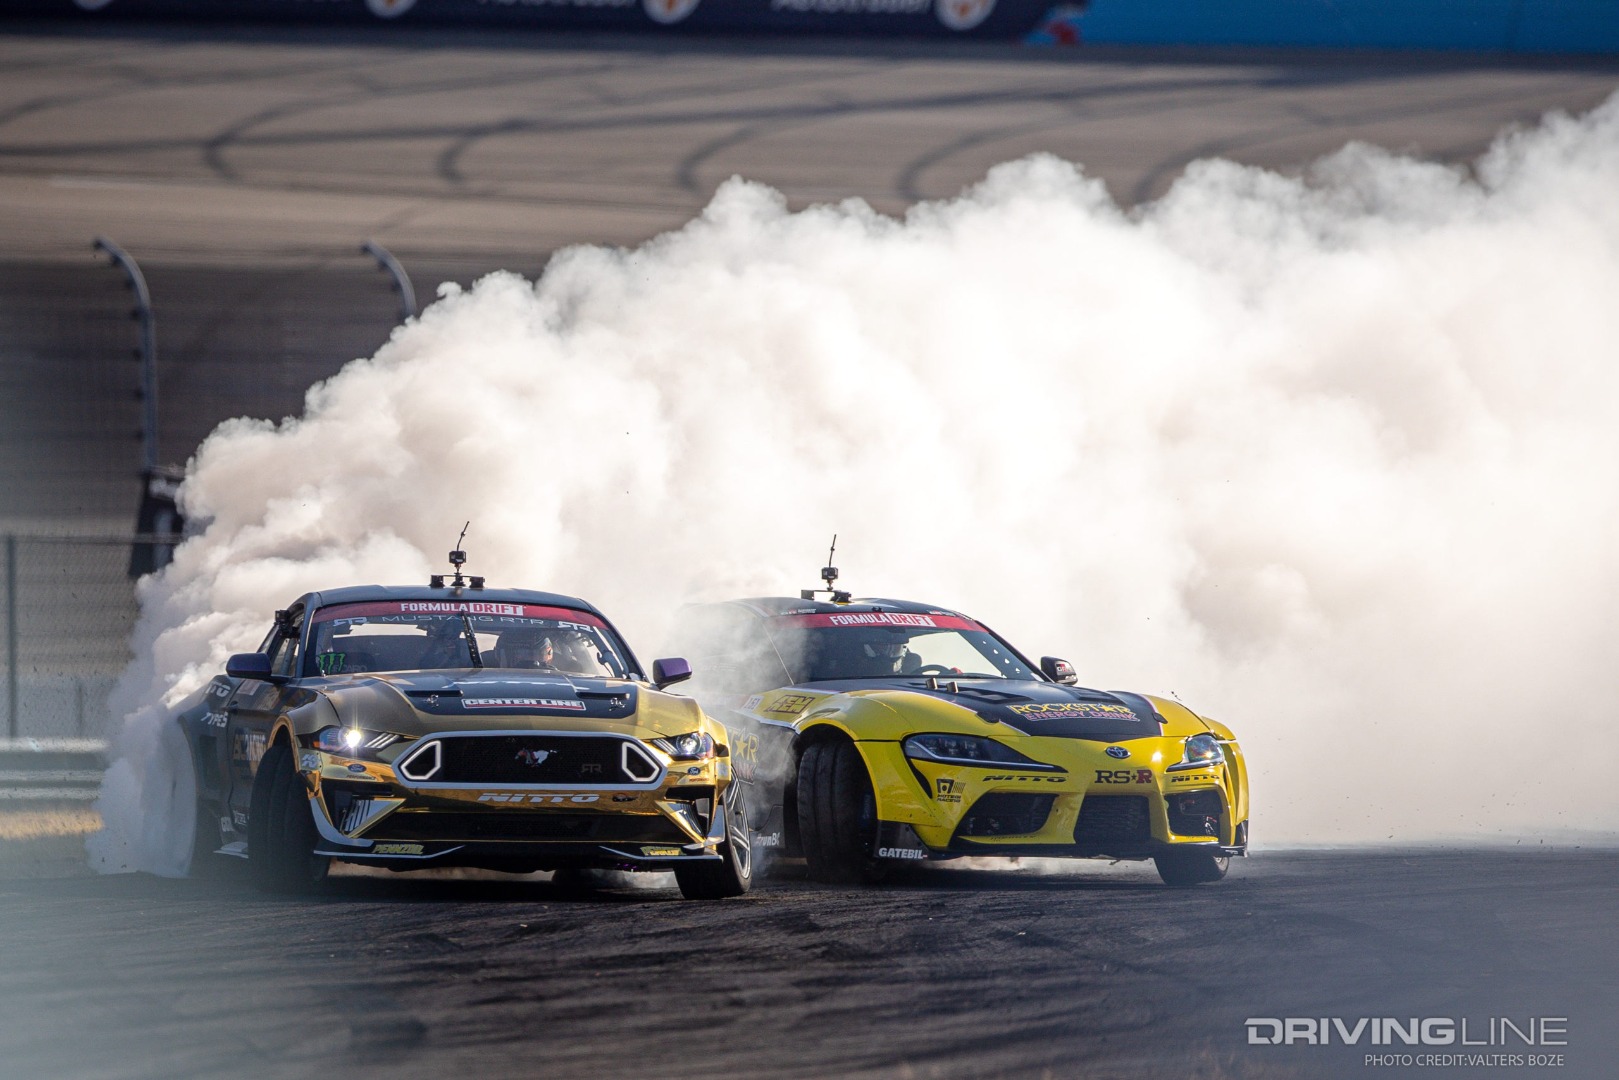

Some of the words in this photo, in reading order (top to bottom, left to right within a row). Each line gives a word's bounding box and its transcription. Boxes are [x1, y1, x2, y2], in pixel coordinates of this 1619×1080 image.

[401, 603, 468, 612] FORMULA
[472, 603, 520, 615] DRIFT
[829, 613, 889, 626] FORMULA
[889, 613, 934, 626] DRIFT
[464, 698, 534, 706] CENTER
[540, 699, 584, 708] LINE
[1026, 711, 1085, 720] ENERGY
[1089, 711, 1137, 720] DRINK
[982, 774, 1067, 783] NITTO
[1171, 774, 1220, 784] NITTO
[477, 792, 600, 804] NITTO
